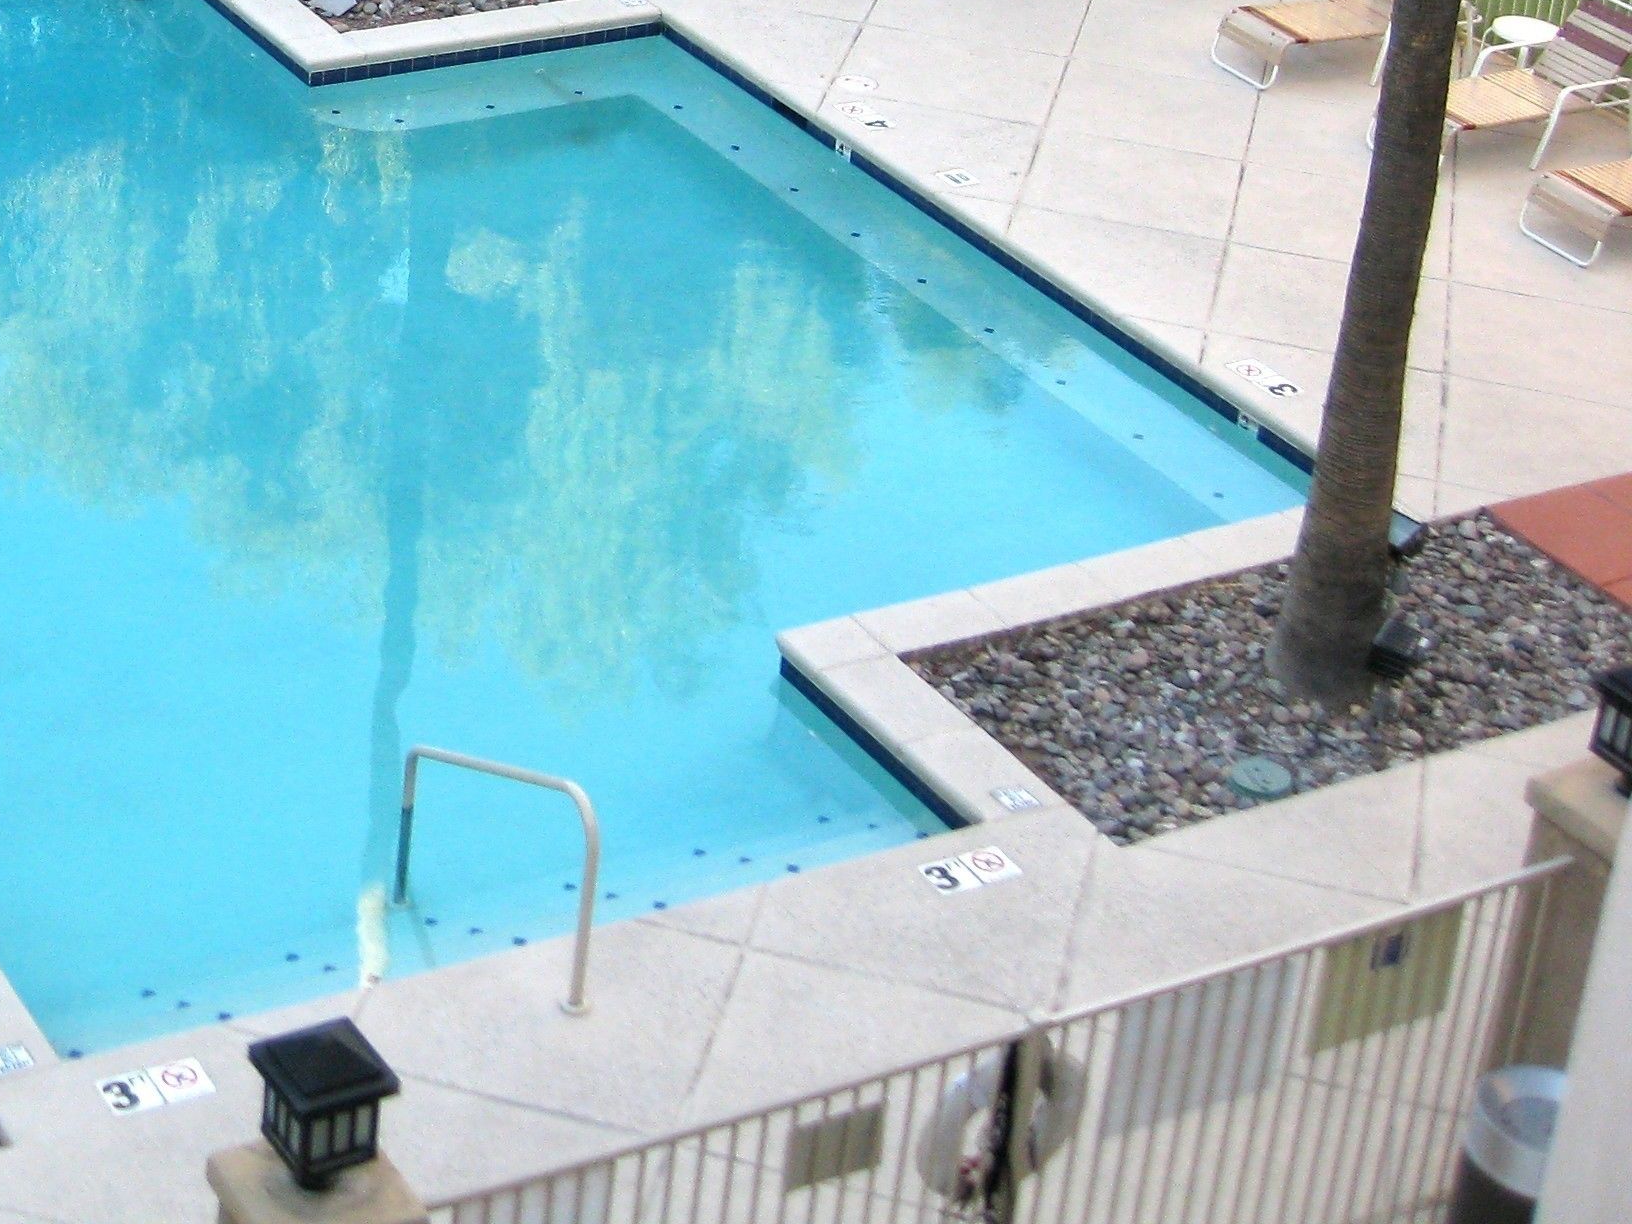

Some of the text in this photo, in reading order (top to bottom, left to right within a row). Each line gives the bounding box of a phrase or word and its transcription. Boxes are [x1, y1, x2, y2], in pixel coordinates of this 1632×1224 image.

[1269, 383, 1297, 397] 3
[924, 866, 961, 889] 3
[103, 1081, 141, 1110] 3
